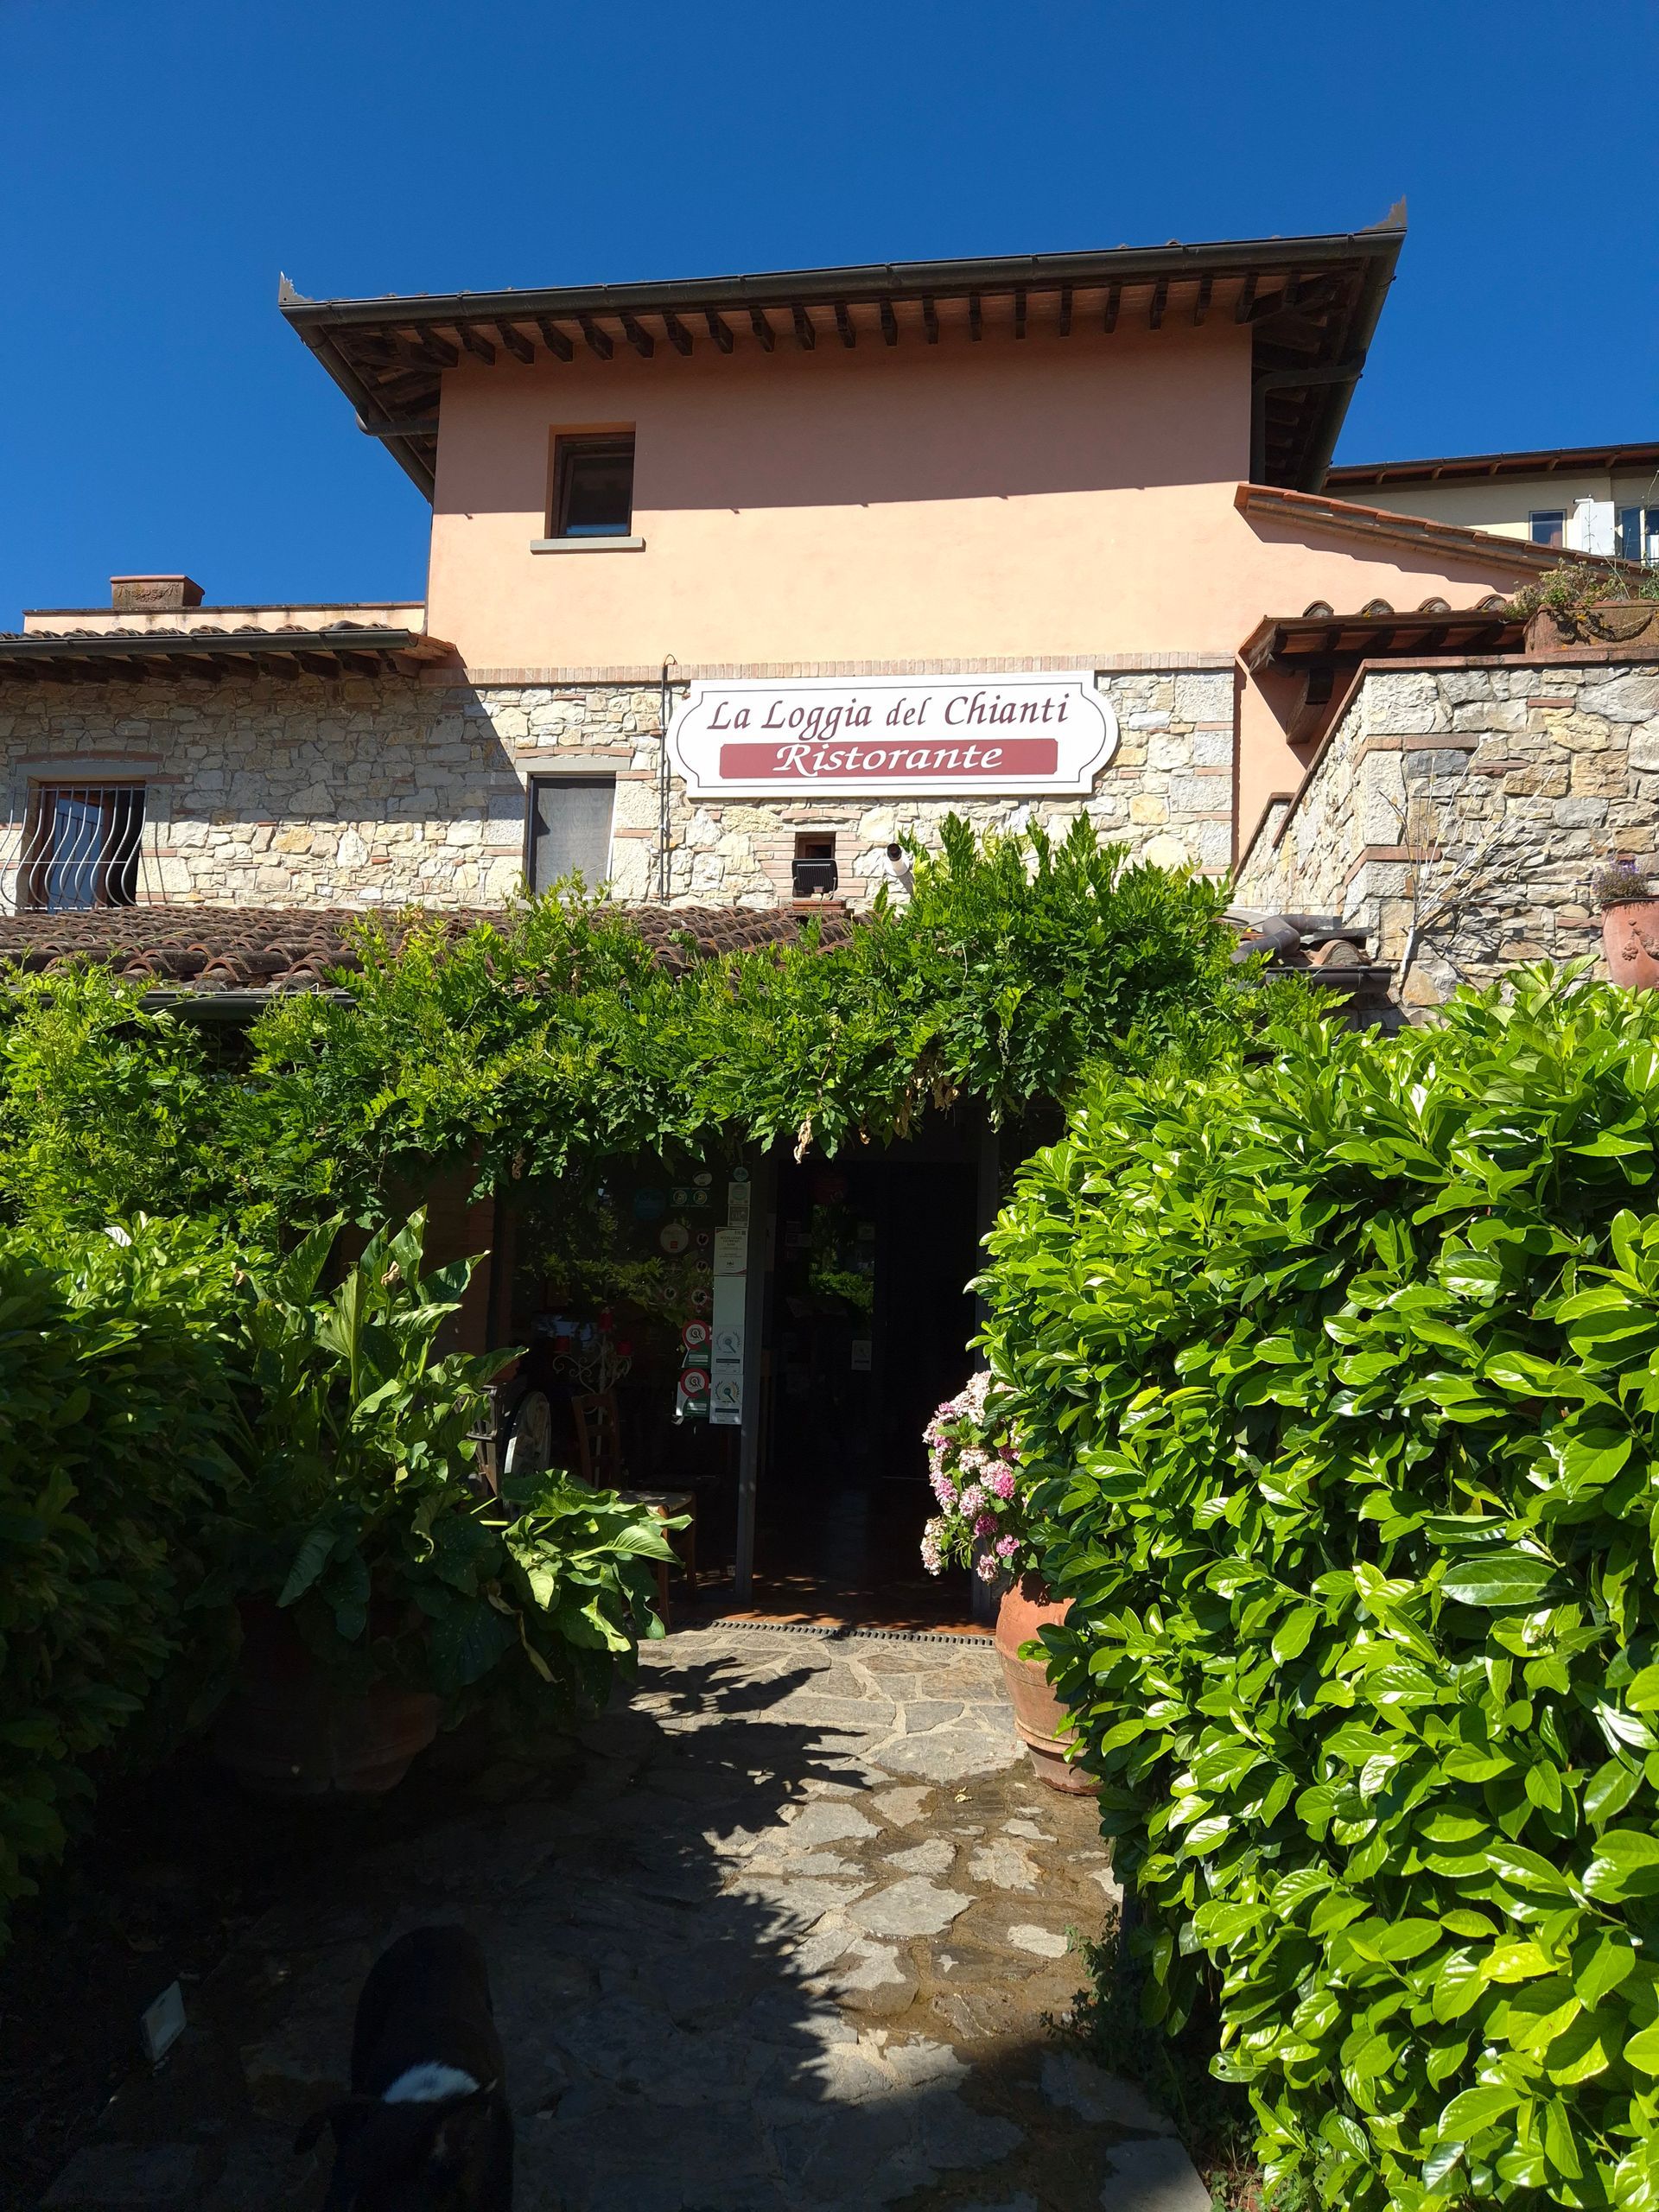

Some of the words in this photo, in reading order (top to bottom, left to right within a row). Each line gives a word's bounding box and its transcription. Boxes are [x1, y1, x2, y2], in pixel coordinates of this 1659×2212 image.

[707, 701, 751, 730] La
[761, 697, 872, 741] Loggia
[886, 696, 932, 727] del
[944, 690, 1071, 726] Chianti
[772, 741, 1003, 777] Ristorante
